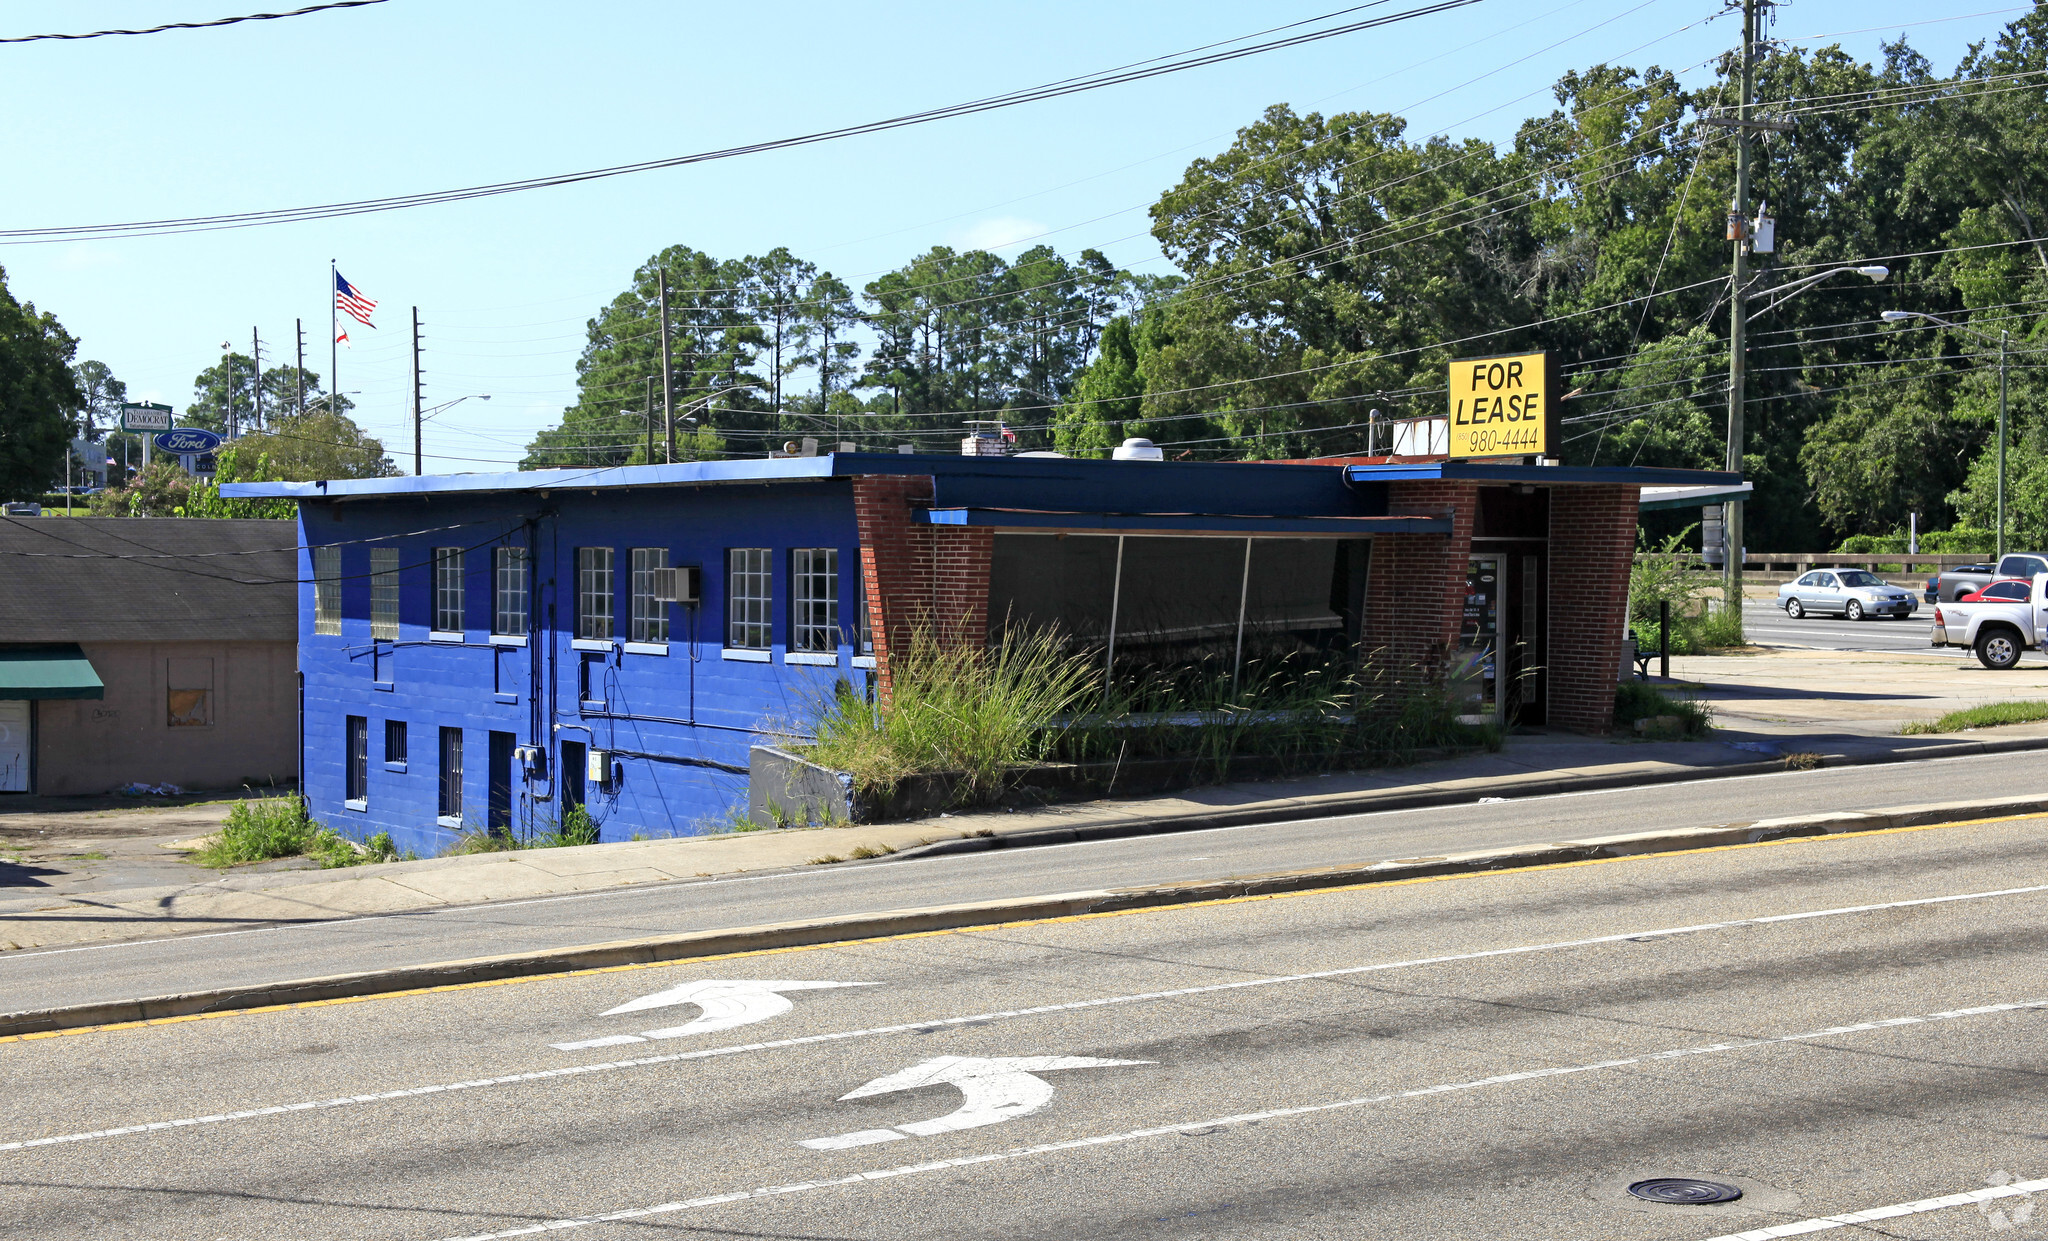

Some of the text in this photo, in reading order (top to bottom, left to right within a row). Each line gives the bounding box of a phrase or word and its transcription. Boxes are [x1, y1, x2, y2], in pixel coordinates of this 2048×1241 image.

[1471, 360, 1523, 391] FOR
[127, 412, 168, 424] DEMOCRAT
[1456, 393, 1539, 425] LEASE
[168, 433, 207, 449] Ford
[1469, 427, 1538, 452] 980-4444
